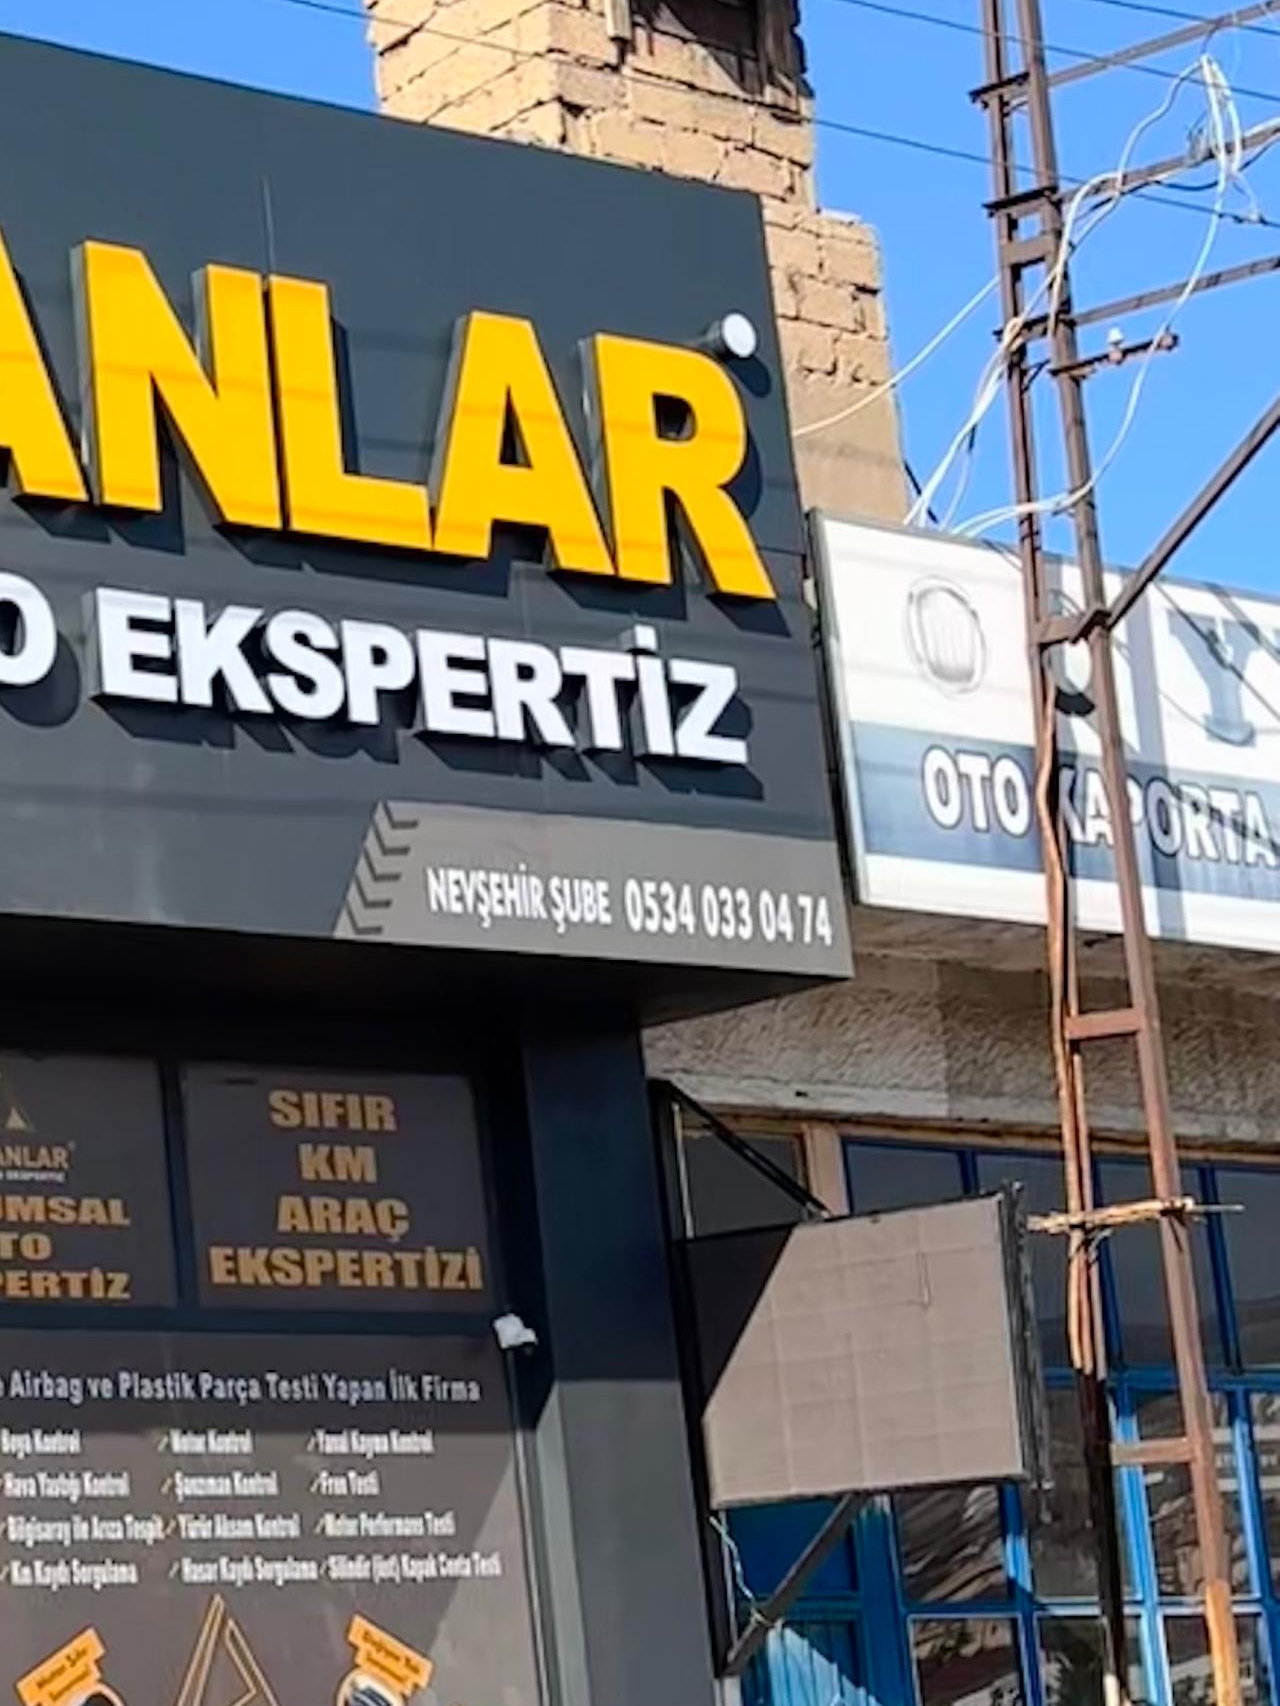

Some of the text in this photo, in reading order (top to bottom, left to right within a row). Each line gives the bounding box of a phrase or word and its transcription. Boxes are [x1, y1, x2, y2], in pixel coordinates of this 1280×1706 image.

[92, 581, 748, 768] EKSPERTİZ
[922, 744, 1032, 838] OTO
[426, 863, 834, 947] NEVŞEHİR ŞUBE 0534 033 04 74
[269, 1090, 397, 1131] SIFIR
[299, 1143, 377, 1183] KM
[277, 1195, 410, 1243] ARAÇ
[209, 1246, 483, 1289] EKSPERTİZİ
[10, 1369, 82, 1405] Airbag
[89, 1375, 113, 1398] ve
[118, 1371, 195, 1400] Plastik
[199, 1372, 262, 1406] Parça
[266, 1372, 319, 1401] Testi
[322, 1373, 387, 1407] Yapan
[423, 1374, 482, 1402] Firma
